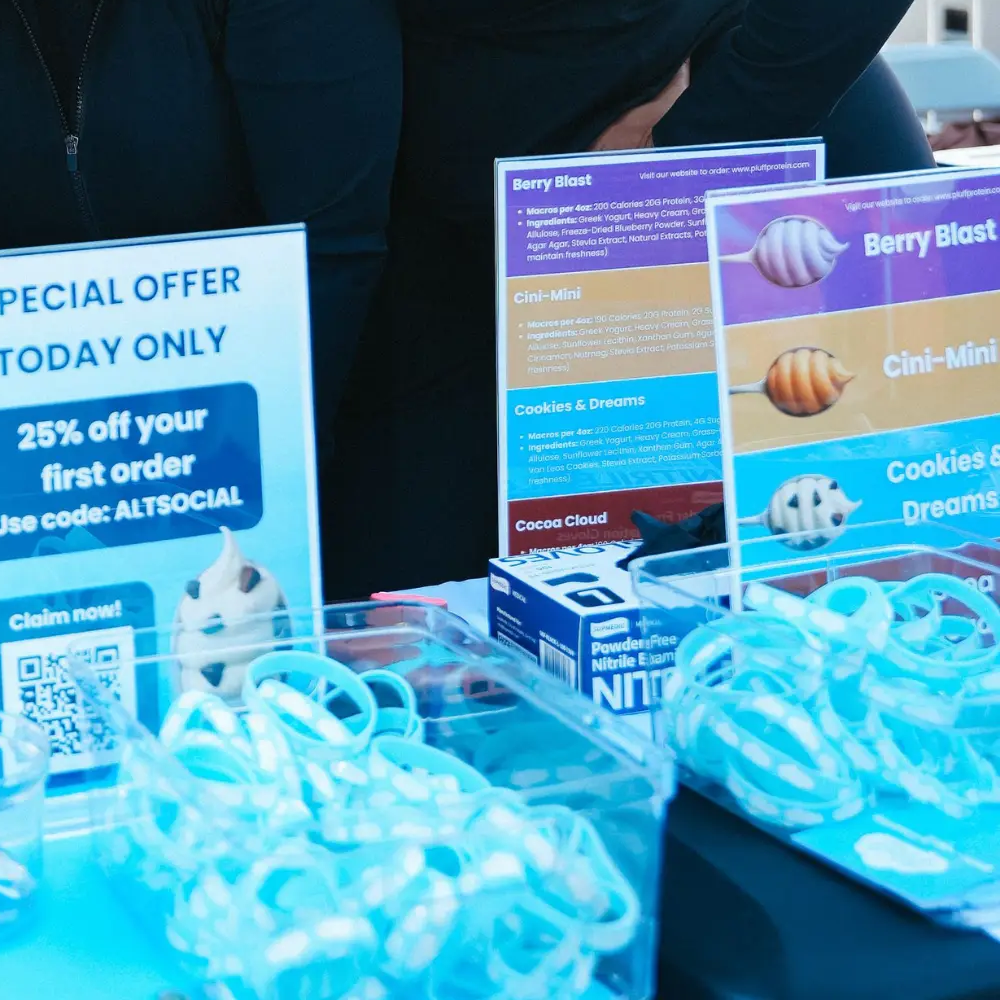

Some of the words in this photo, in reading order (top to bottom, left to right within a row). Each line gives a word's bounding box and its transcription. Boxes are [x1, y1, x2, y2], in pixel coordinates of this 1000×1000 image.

[639, 172, 655, 180] Visit
[670, 169, 698, 178] website
[731, 162, 810, 174] www.pluffprotein.com
[512, 178, 552, 192] Berry
[555, 173, 592, 187] Blast
[527, 207, 558, 216] Macros
[560, 206, 574, 215] per
[575, 204, 592, 212] 4oz:
[594, 202, 608, 211] 200
[610, 200, 643, 210] Calories
[644, 198, 660, 207] 20G
[662, 196, 692, 206] Protein,
[845, 203, 860, 212] Visit
[876, 198, 903, 208] website
[527, 216, 577, 228] Ingredients:
[578, 214, 602, 223] Greek
[604, 212, 632, 223] Yogurt,
[634, 211, 659, 220] Heavy
[660, 209, 690, 218] Cream,
[527, 229, 560, 238] Allulose,
[561, 224, 613, 236] Freeze-Dried
[614, 222, 653, 232] Blueberry
[654, 220, 685, 229] Powder,
[864, 230, 932, 258] Berry
[935, 219, 997, 248] Blast
[527, 241, 547, 251] Agar
[549, 240, 570, 250] Agar,
[571, 237, 597, 246] Stevia
[598, 235, 627, 245] Extract,
[629, 232, 659, 242] Natural
[527, 251, 564, 261] maintain
[565, 247, 608, 258] freshness)
[134, 266, 240, 301] OFFER
[514, 287, 581, 304] Cini-Mini
[527, 320, 559, 328] Macros
[560, 319, 574, 328] per
[609, 312, 641, 322] Calories
[527, 328, 578, 341] Ingredients:
[579, 326, 604, 335] Greek
[635, 323, 659, 331] Heavy
[133, 325, 227, 361] ONLY
[562, 338, 602, 348] Sunflower
[610, 346, 635, 356] Stevia
[883, 338, 998, 379] Cini-Mini
[514, 400, 572, 416] Cookies
[574, 399, 586, 411] &
[589, 395, 646, 410] Dreams
[17, 418, 84, 450] 25%
[88, 410, 131, 442] off
[135, 408, 208, 445] your
[528, 431, 559, 440] Macros
[561, 429, 575, 438] per
[576, 427, 593, 435] 4oz:
[611, 422, 644, 432] Calories
[528, 440, 578, 452] Ingredients:
[580, 437, 603, 447] Greek
[635, 433, 660, 442] Heavy
[563, 449, 602, 459] Sunflower
[637, 442, 671, 453] Xanthan
[601, 457, 626, 467] Stevia
[658, 451, 700, 462] Potassium
[886, 449, 985, 484] Cookies
[41, 461, 106, 493] first
[110, 452, 196, 484] order
[529, 474, 571, 485] freshness)
[40, 504, 112, 530] code:
[114, 485, 243, 522] ALTSOCIAL
[902, 490, 999, 526] Dreams
[515, 518, 562, 532] Cocoa
[565, 512, 608, 527] Cloud
[9, 608, 70, 631] Claim
[73, 600, 122, 622] now!
[592, 654, 635, 672] Nitrile
